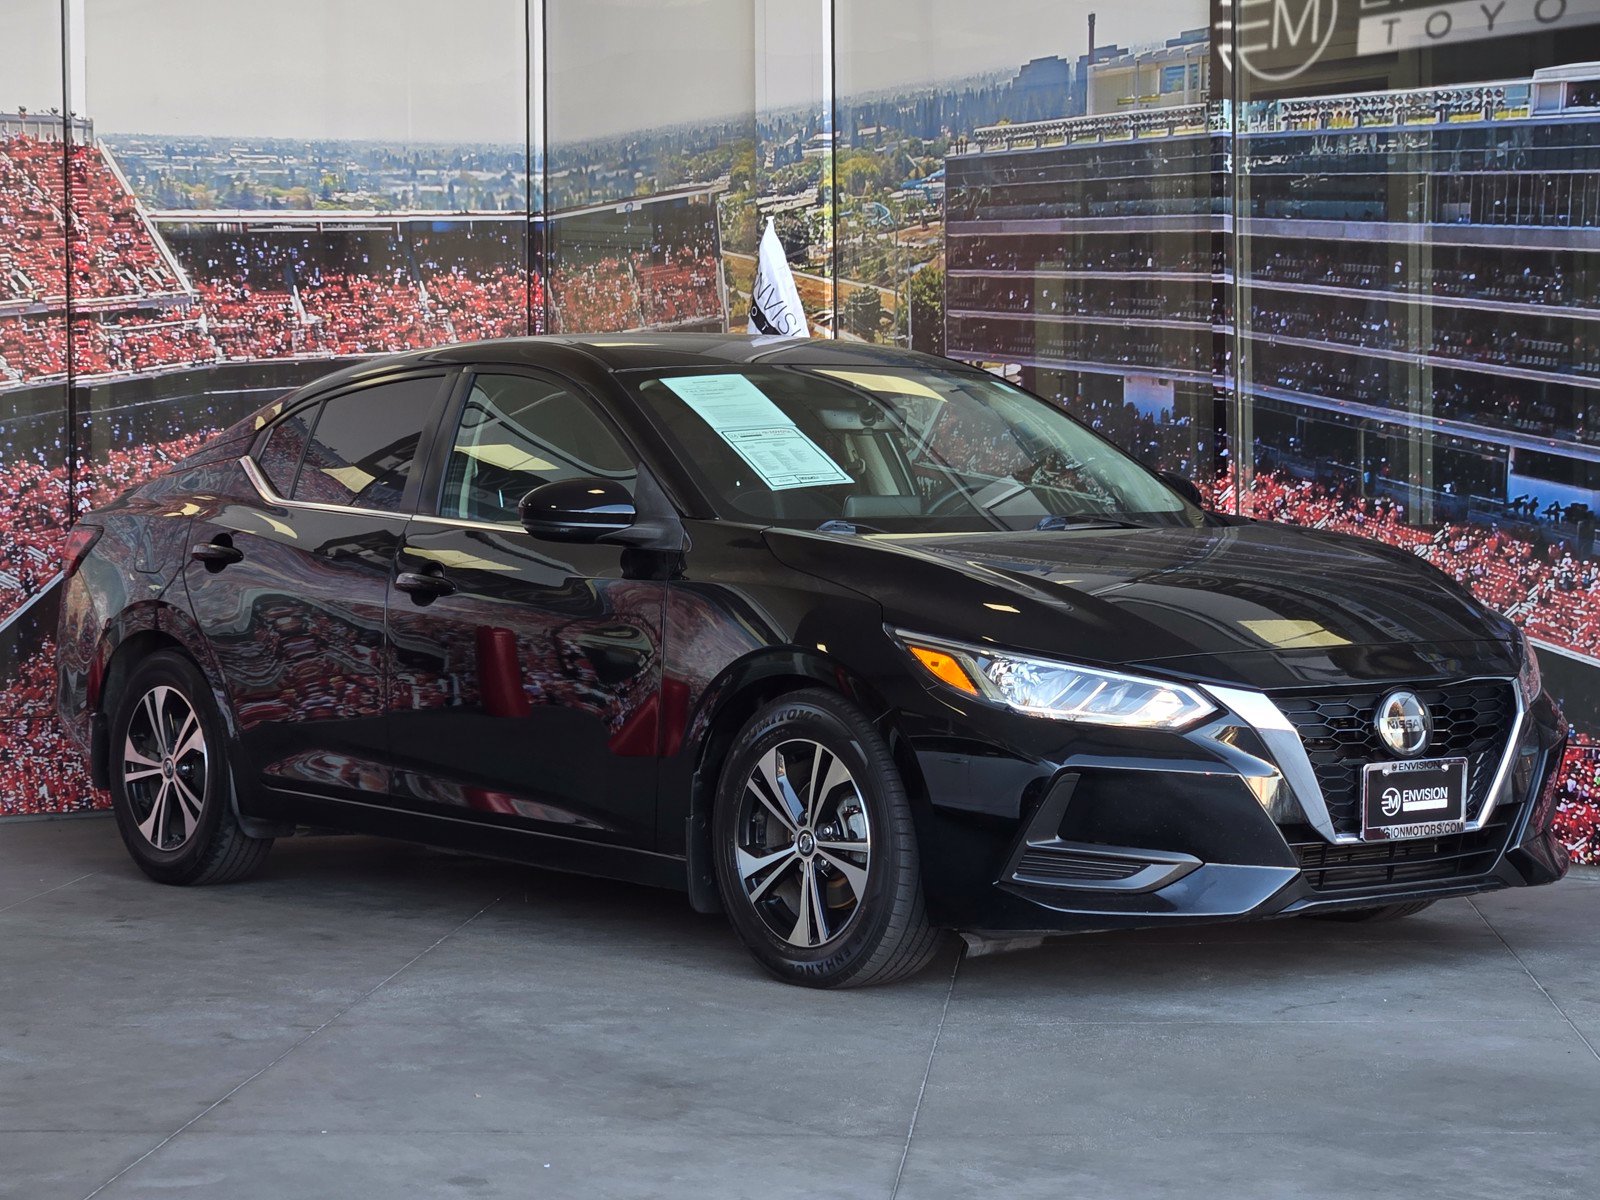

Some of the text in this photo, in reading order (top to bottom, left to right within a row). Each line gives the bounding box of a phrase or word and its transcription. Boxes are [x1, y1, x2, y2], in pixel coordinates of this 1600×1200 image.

[1387, 718, 1423, 730] NISSA
[1399, 761, 1441, 771] ENVISION
[1403, 787, 1448, 802] ENVISION
[1381, 821, 1464, 840] SIONMOTORS.COM
